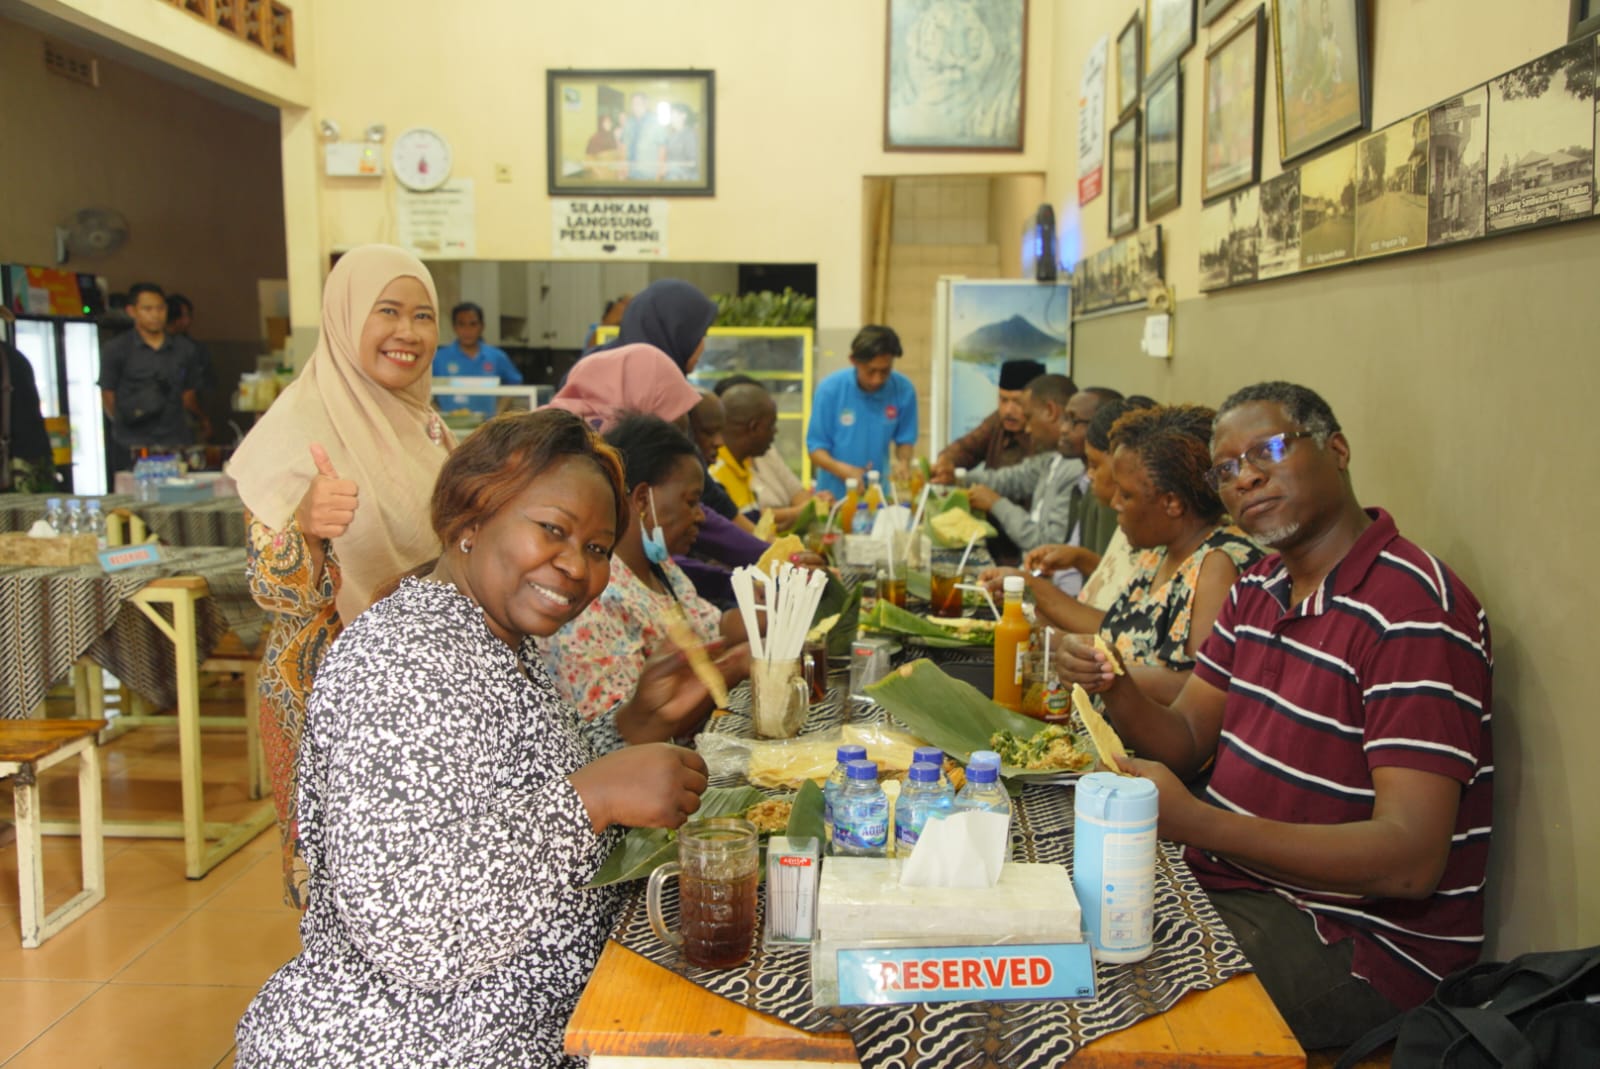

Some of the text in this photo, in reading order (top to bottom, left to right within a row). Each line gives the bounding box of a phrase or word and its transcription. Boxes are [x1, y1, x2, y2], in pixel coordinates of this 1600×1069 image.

[570, 203, 649, 214] SILAHKAN
[567, 216, 652, 228] LANGSUNG
[560, 229, 659, 241] PESAN DISINI
[862, 822, 886, 837] AQUA
[879, 957, 1053, 991] RESERVED
